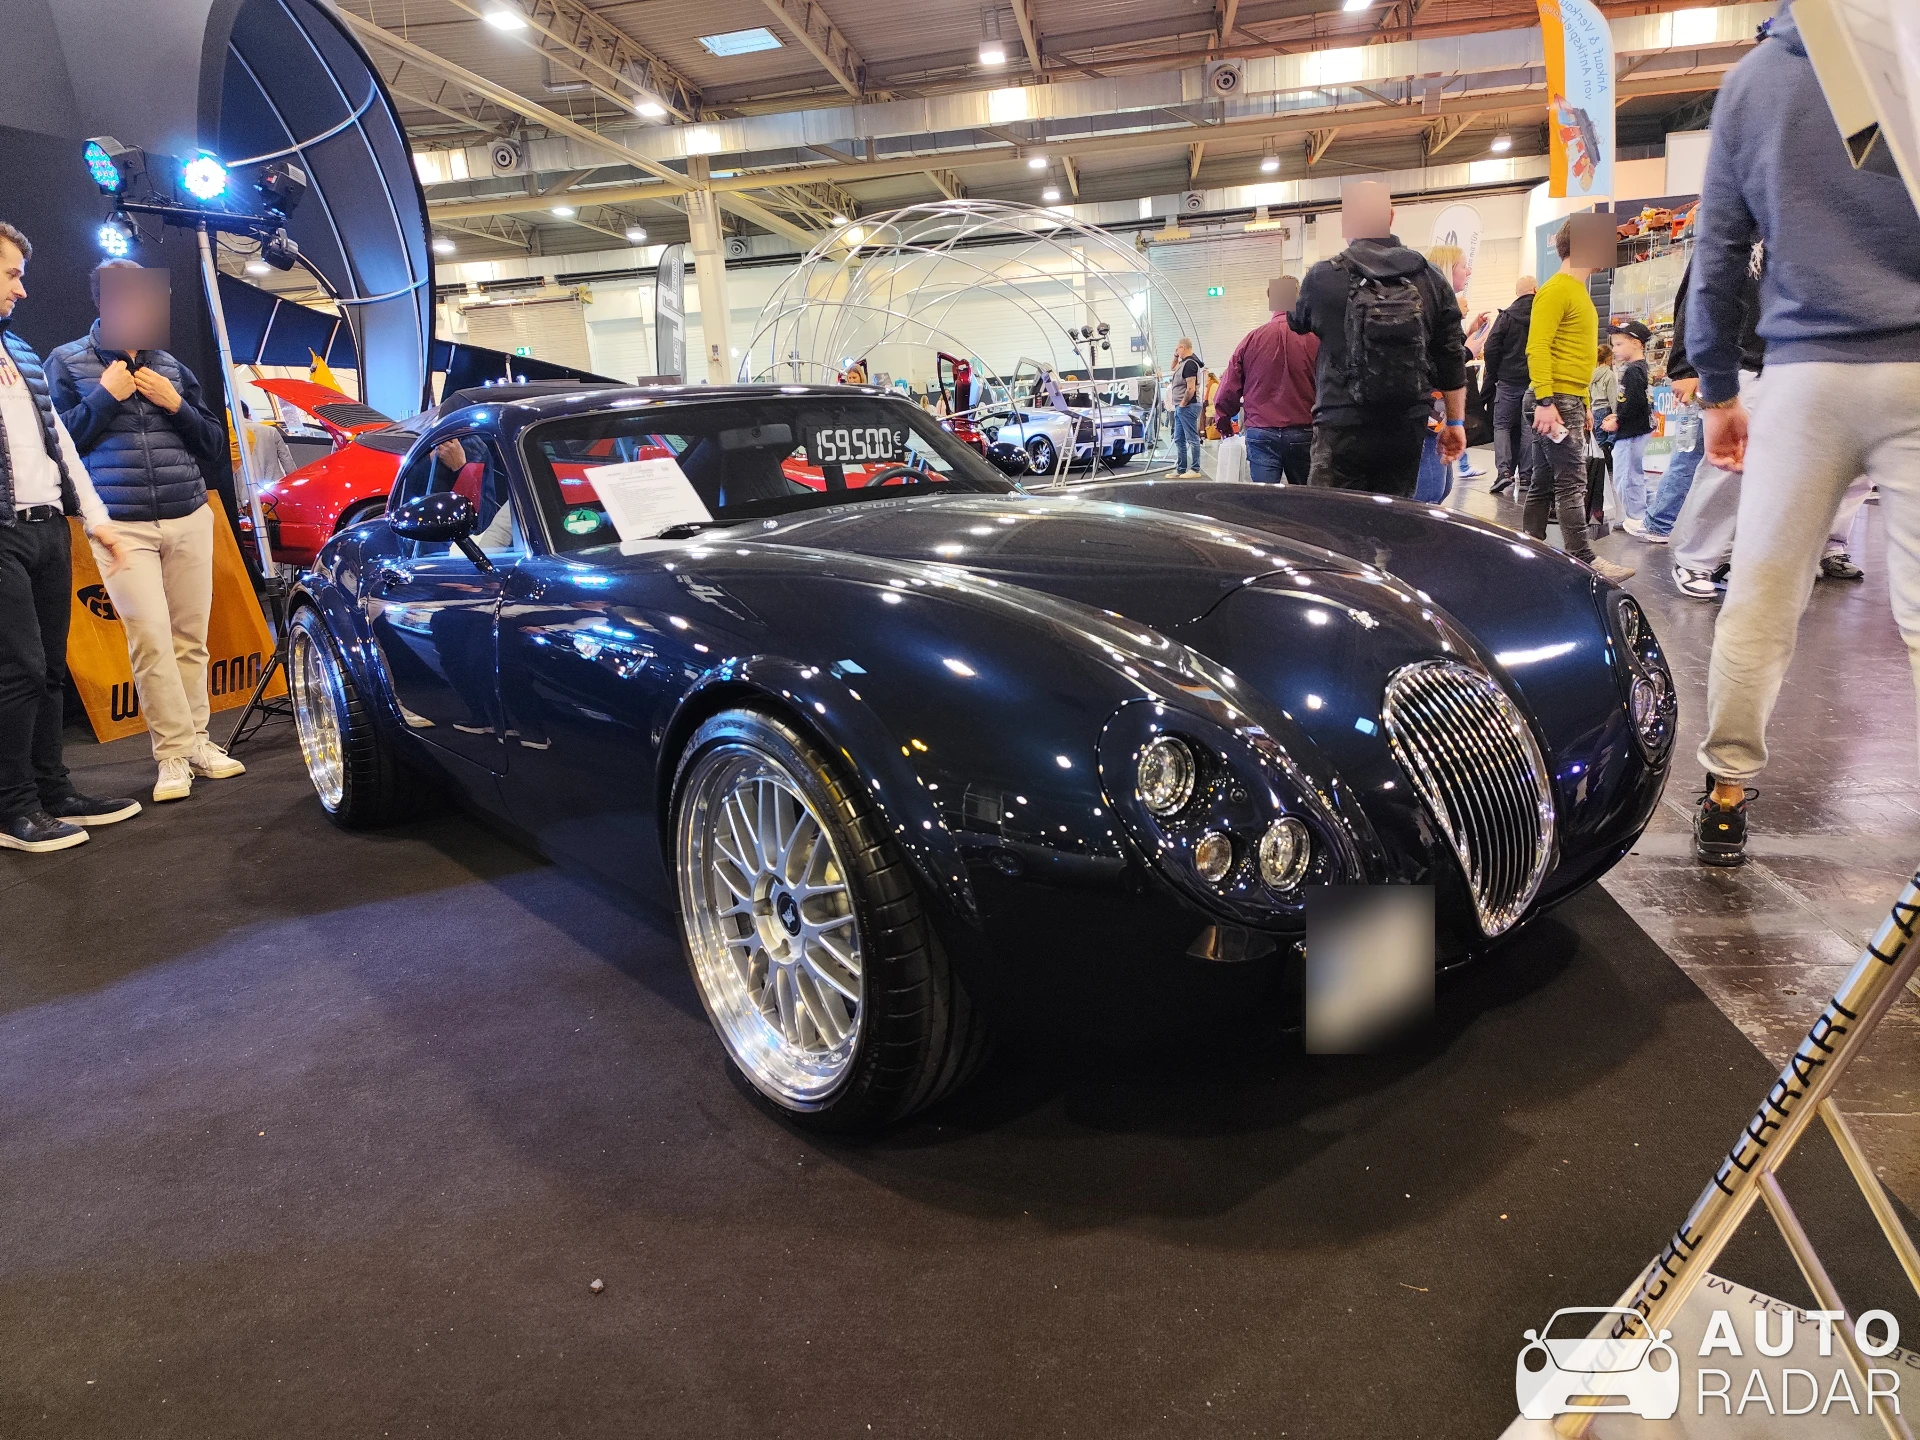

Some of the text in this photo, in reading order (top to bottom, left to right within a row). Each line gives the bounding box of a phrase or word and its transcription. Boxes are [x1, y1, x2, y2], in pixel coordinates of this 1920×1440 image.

[816, 427, 893, 462] 159.500
[577, 510, 587, 522] 4
[1713, 998, 1858, 1196] FERRARI
